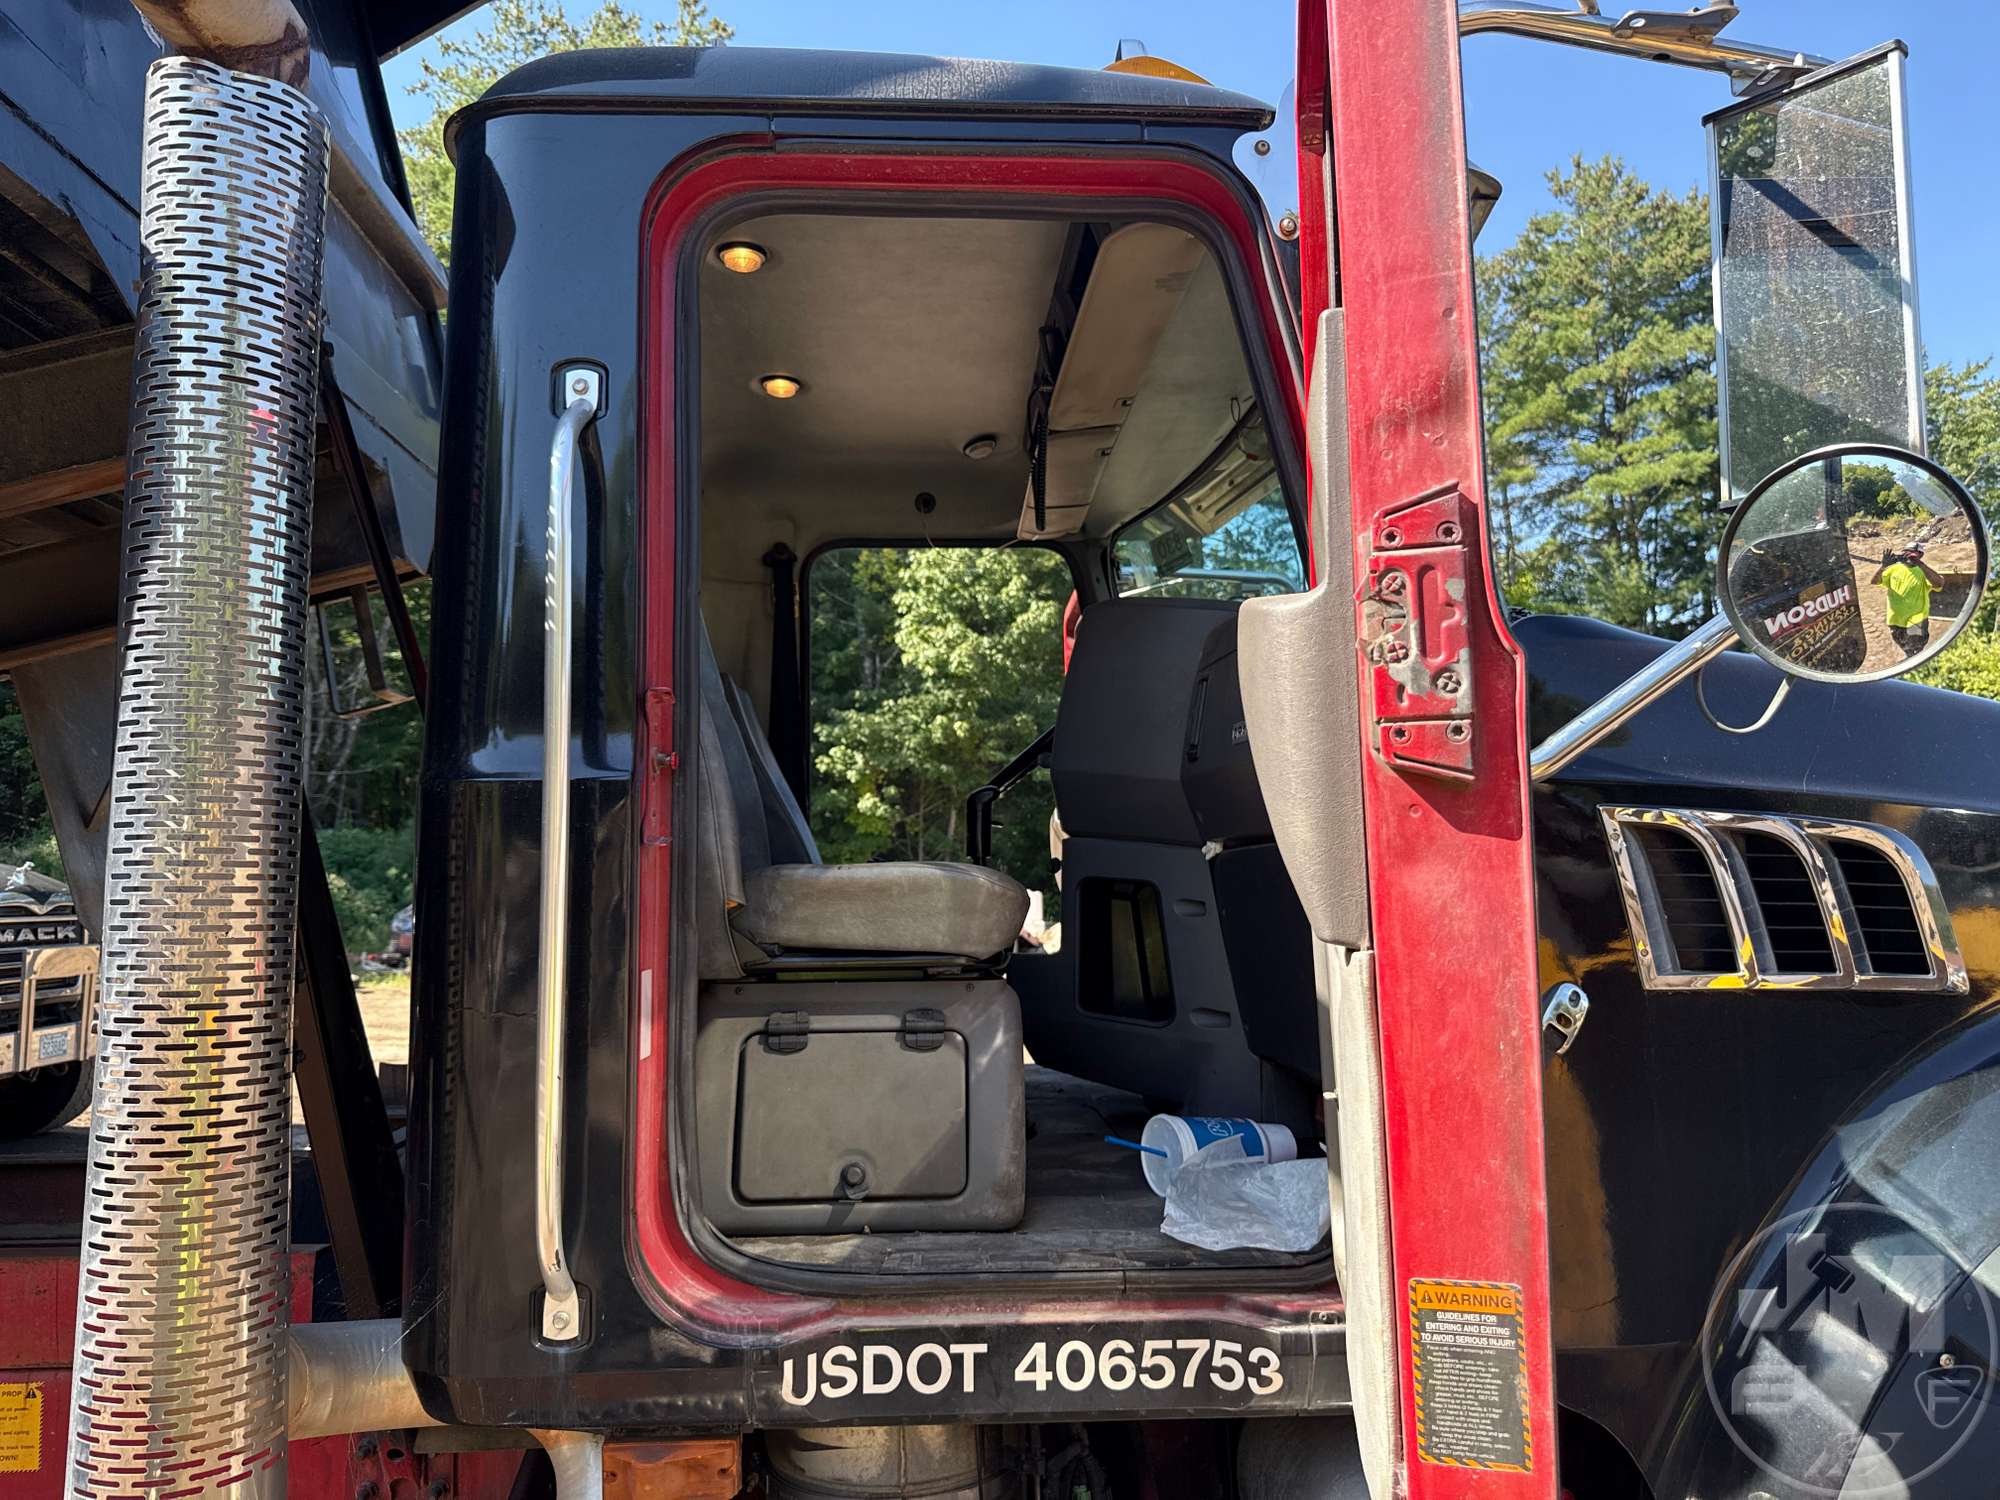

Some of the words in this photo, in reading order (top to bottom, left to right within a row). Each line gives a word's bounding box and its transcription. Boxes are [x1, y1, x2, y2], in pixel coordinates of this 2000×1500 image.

[0, 926, 77, 943] MACK
[1435, 1292, 1512, 1309] WARNING
[1437, 1311, 1480, 1322] GUIDELINES
[1481, 1314, 1497, 1323] FOR
[1426, 1322, 1462, 1332] ENTERING
[1463, 1325, 1479, 1333] AND
[1481, 1326, 1510, 1335] EXITING
[1421, 1333, 1431, 1341] TO
[1432, 1334, 1454, 1342] AVOID
[1456, 1335, 1488, 1345] SERIOUS
[1489, 1338, 1515, 1347] INJURY
[781, 1343, 988, 1406] USDOT
[1015, 1339, 1284, 1396] 4065753
